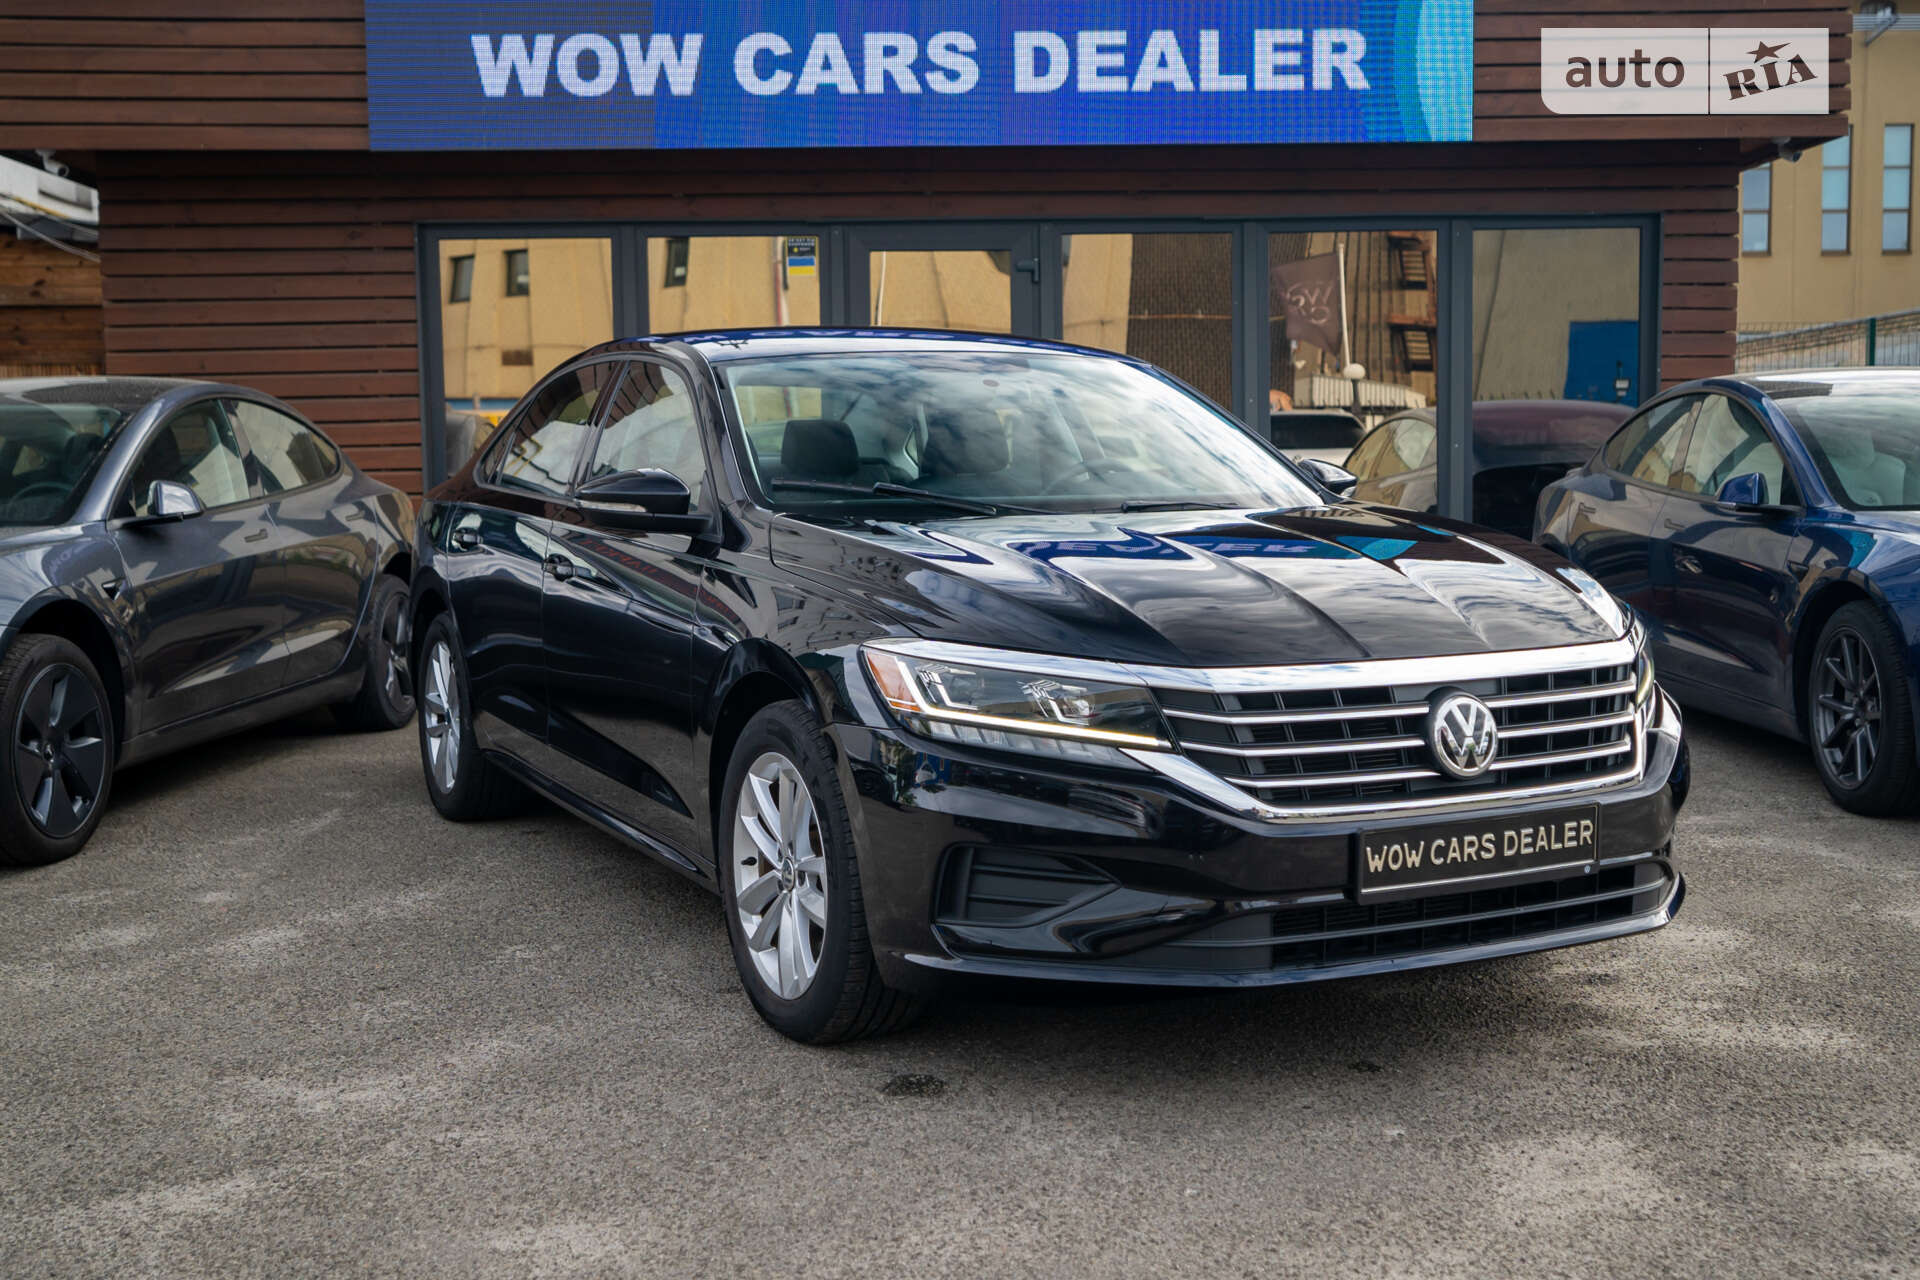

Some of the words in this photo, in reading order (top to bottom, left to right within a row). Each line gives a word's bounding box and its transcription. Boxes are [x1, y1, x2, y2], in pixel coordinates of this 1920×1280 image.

[470, 32, 704, 98] WOW
[732, 30, 981, 97] CARS
[1013, 27, 1372, 95] DEALER
[1365, 840, 1425, 873] WOW
[1429, 832, 1497, 865] CARS
[1503, 819, 1594, 857] DEALER
